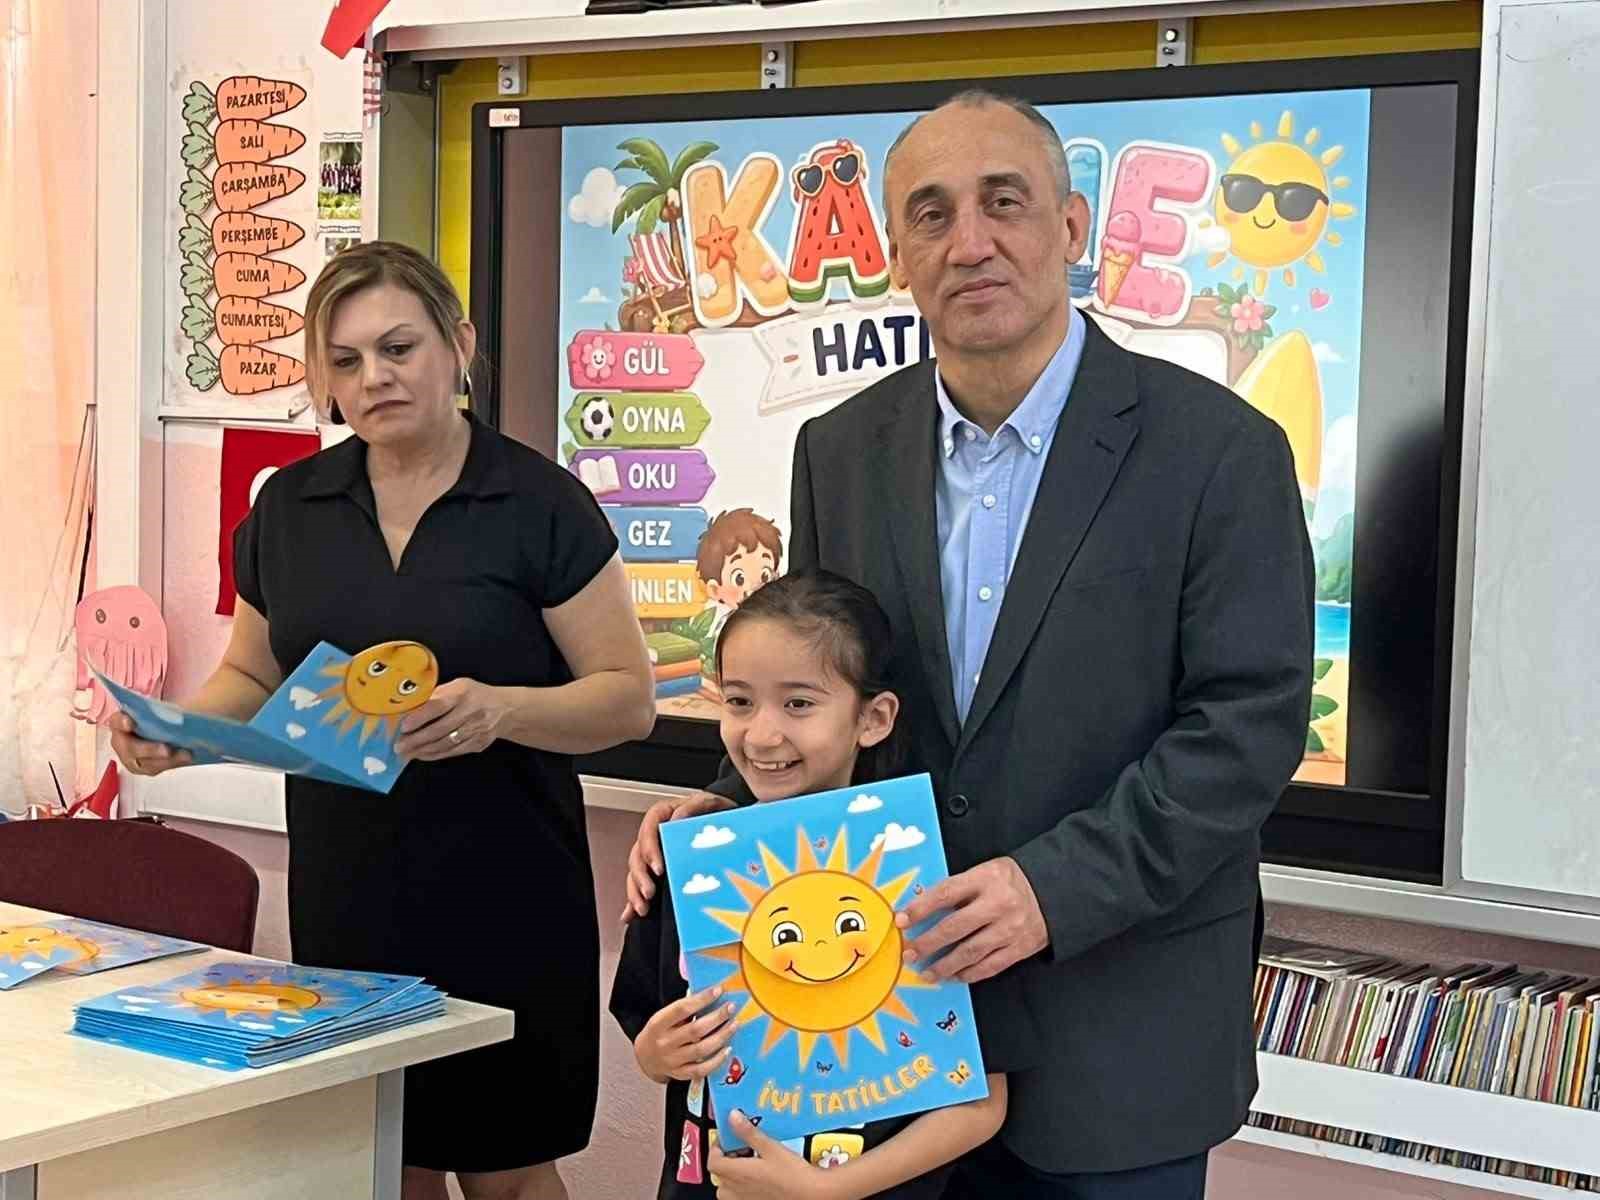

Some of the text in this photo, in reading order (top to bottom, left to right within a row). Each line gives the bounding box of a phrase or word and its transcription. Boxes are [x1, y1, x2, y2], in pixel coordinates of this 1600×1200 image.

[239, 135, 264, 149] SALI
[221, 173, 286, 195] ÇARŞAMBA
[221, 227, 279, 246] PERŞEMBE
[236, 269, 270, 282] CUMA
[623, 340, 670, 376] GÜL
[812, 315, 930, 377] HATI
[240, 362, 277, 376] PAZAR
[622, 406, 686, 434] OYNA
[628, 463, 676, 490] OKU
[628, 520, 672, 547] GEZ
[631, 572, 693, 604] İNLEN
[811, 1055, 936, 1115] TATİLLER
